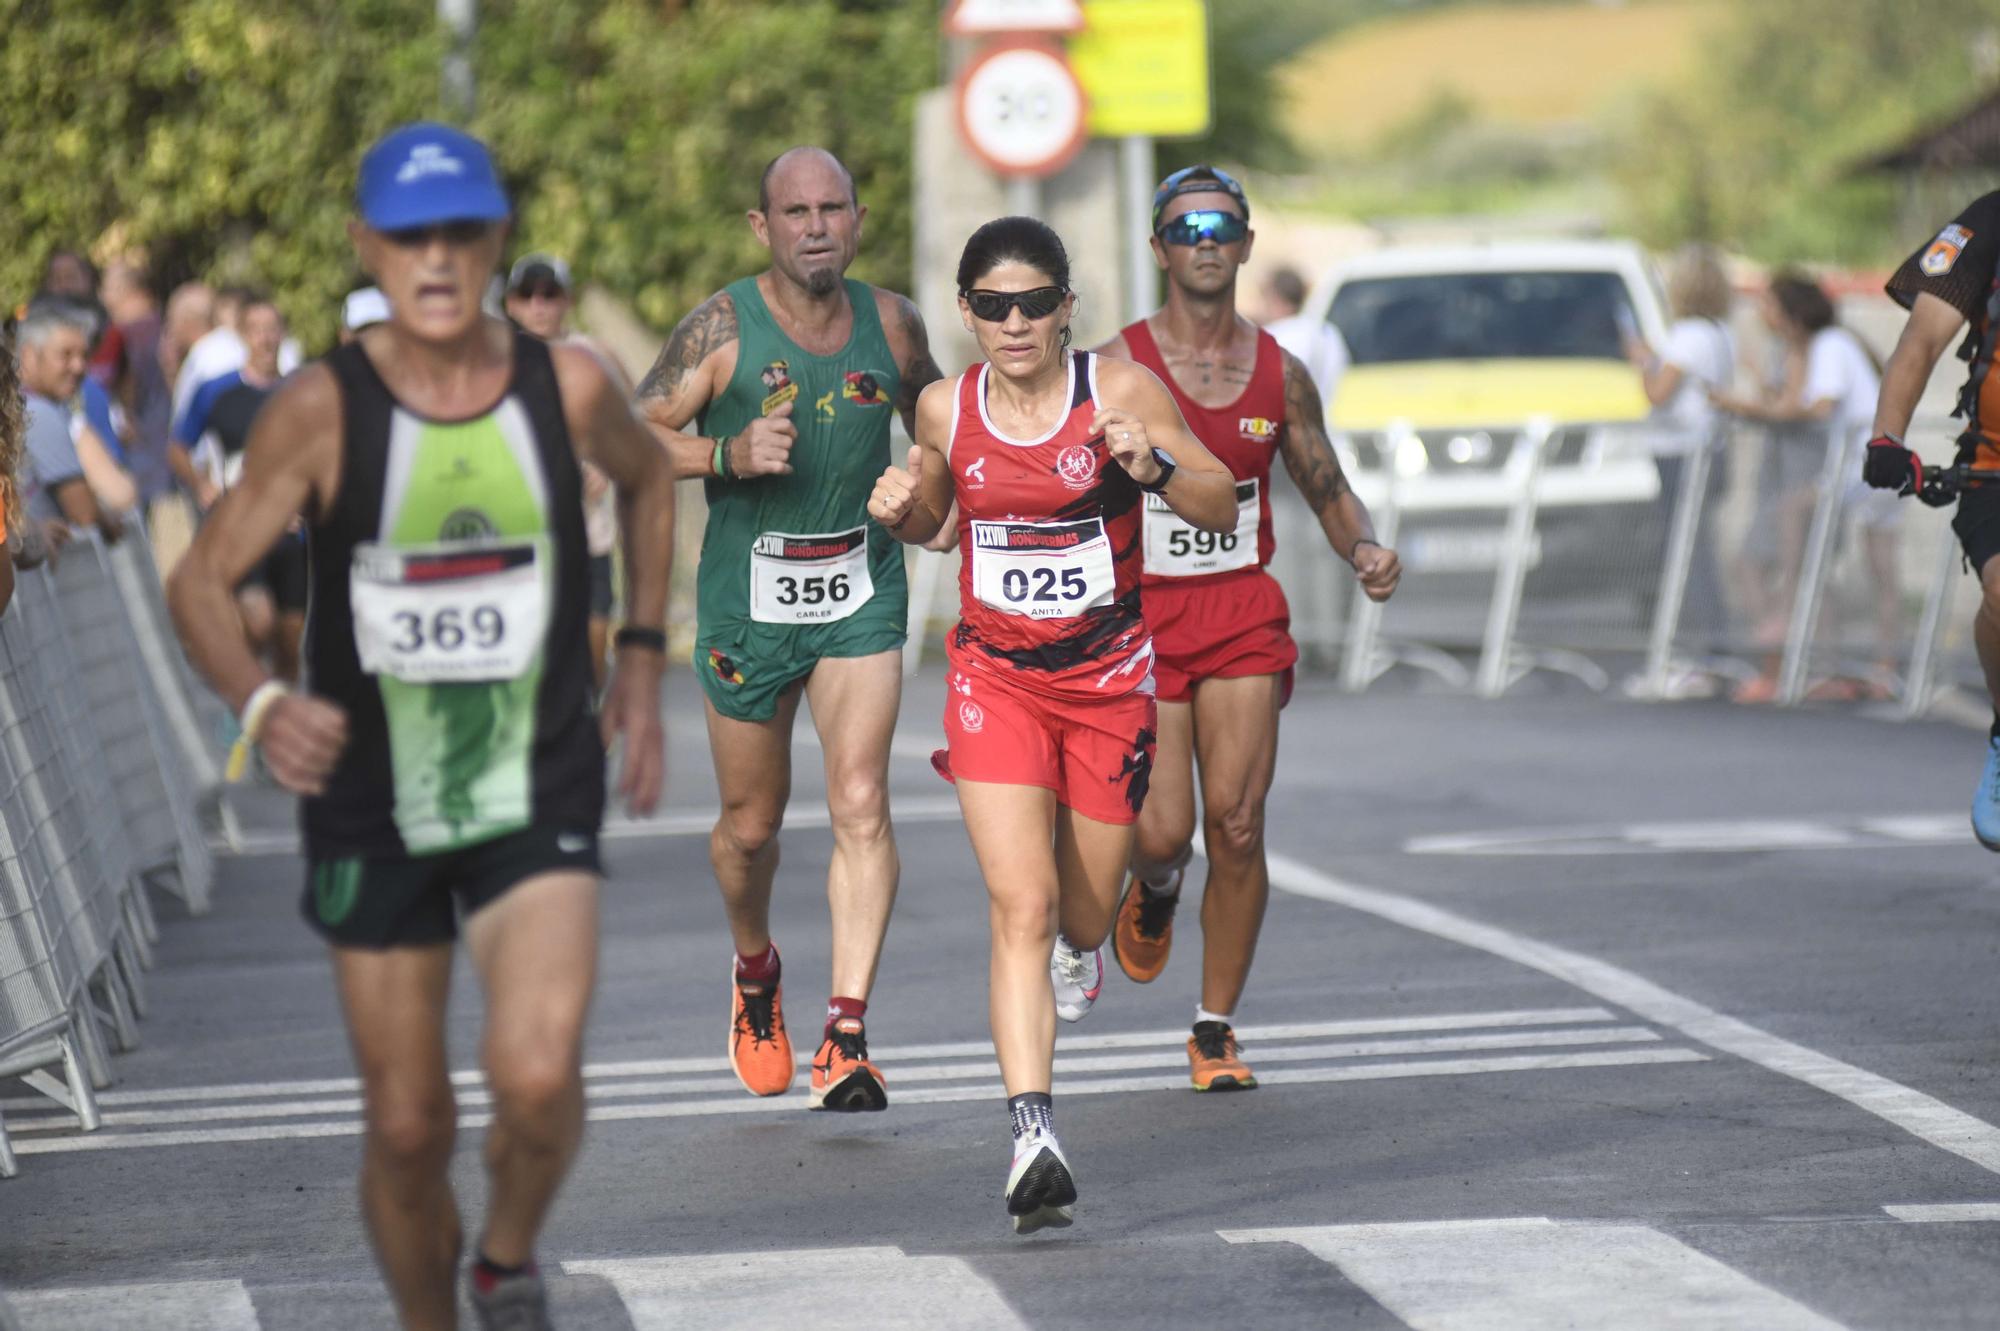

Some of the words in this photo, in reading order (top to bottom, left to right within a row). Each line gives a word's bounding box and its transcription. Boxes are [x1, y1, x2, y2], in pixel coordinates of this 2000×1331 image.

[976, 525, 1008, 547] XXVIII
[1008, 532, 1080, 547] NONDUERMAS
[1169, 528, 1238, 557] 596
[776, 573, 851, 606] 356
[1002, 565, 1088, 603] 025
[1031, 607, 1063, 616] ANITA
[393, 606, 504, 652] 369
